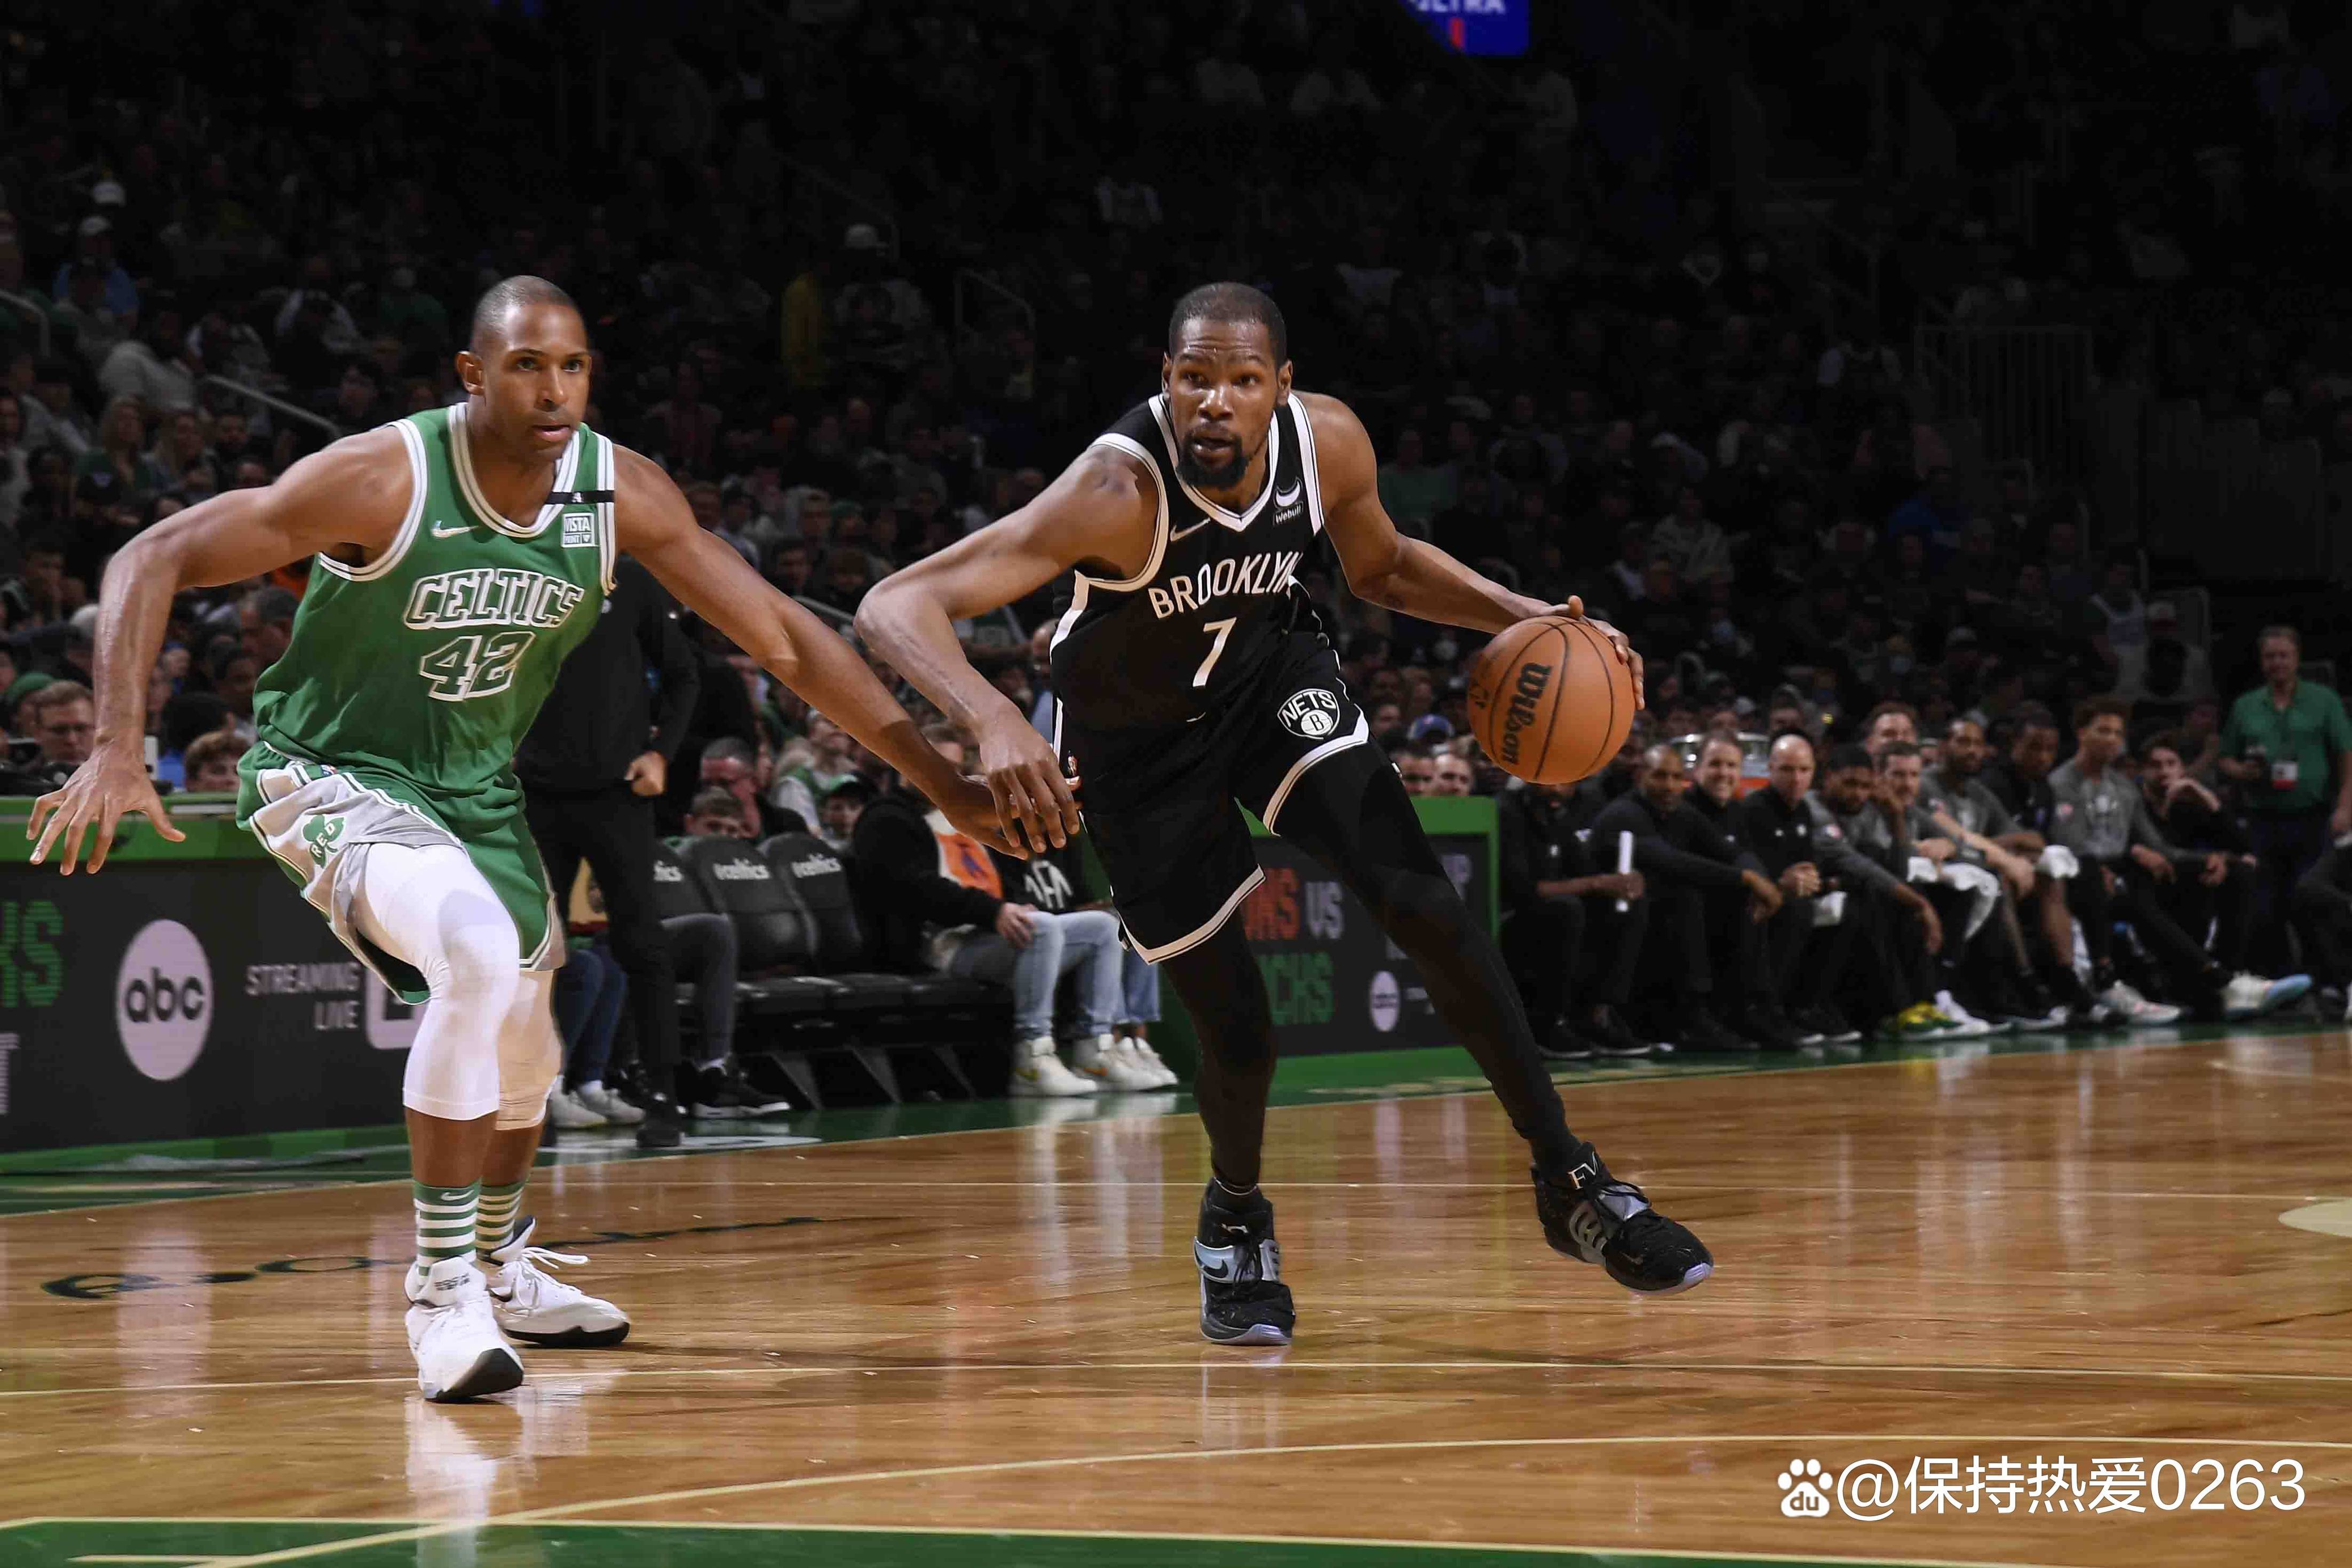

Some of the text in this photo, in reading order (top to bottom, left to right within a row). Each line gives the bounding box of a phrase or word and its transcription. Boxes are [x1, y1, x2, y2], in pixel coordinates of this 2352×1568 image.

[565, 516, 591, 532] VISTA
[1275, 504, 1301, 523] Webull
[404, 568, 585, 630] CELTICS
[419, 631, 536, 702] 42
[1193, 617, 1237, 688] 7
[1282, 691, 1337, 728] NETS
[1309, 714, 1324, 731] B
[1501, 662, 1551, 765] Wilson
[311, 822, 335, 858] RED
[126, 967, 204, 1022] abc
[245, 961, 361, 996] STREAMING
[314, 1000, 359, 1031] LIVE
